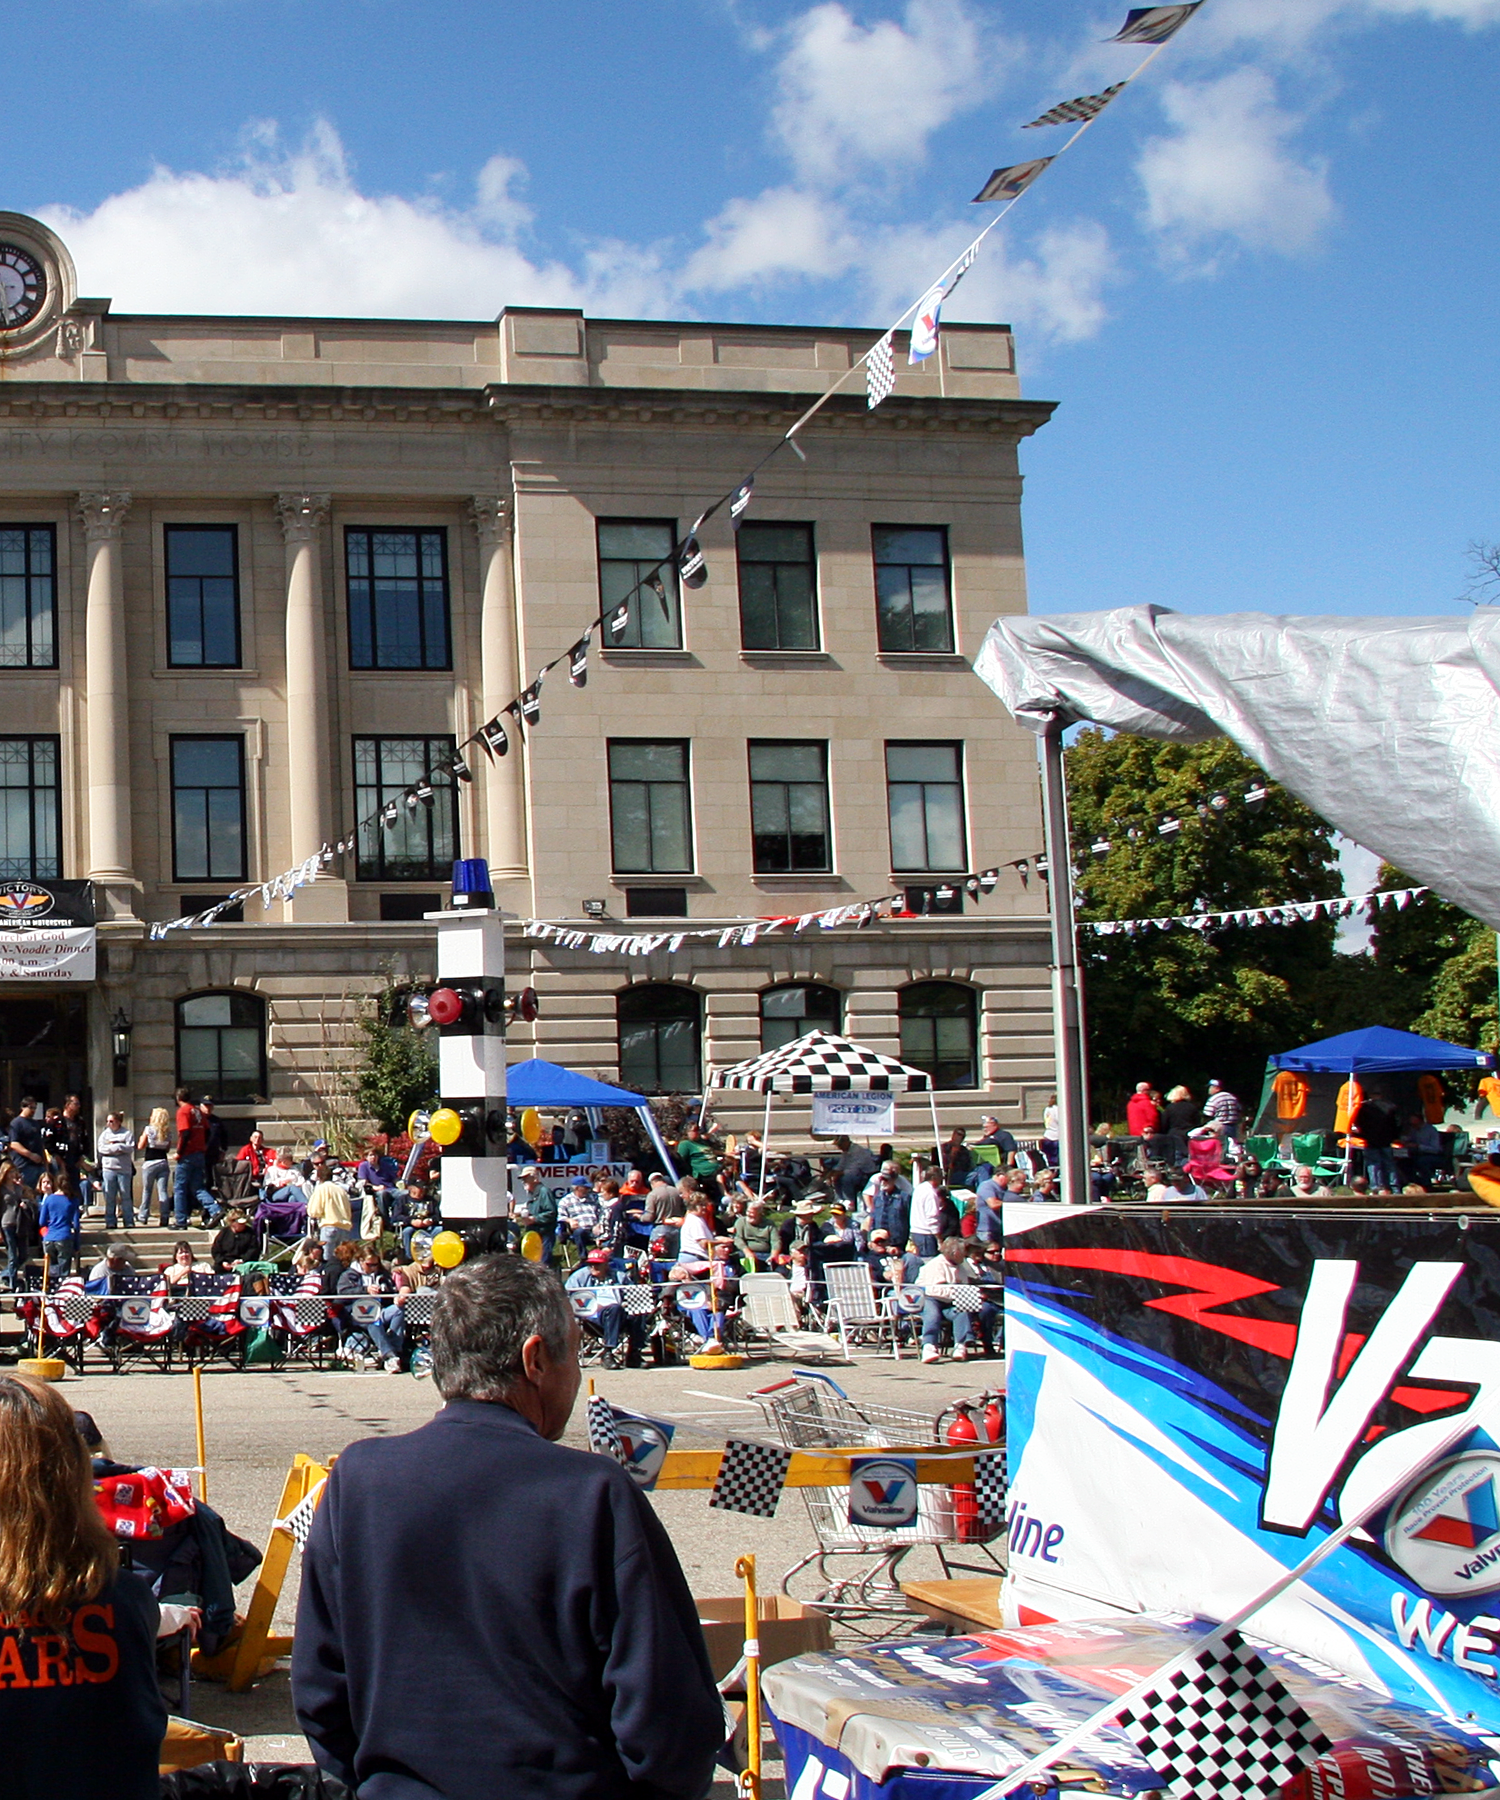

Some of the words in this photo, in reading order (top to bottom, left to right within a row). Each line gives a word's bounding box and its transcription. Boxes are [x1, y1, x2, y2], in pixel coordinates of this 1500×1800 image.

[26, 931, 37, 941] of
[41, 931, 66, 941] God
[54, 944, 92, 954] Dinner
[10, 968, 19, 977] &
[23, 968, 74, 978] Saturday
[813, 1092, 859, 1100] AMERICAN
[861, 1092, 893, 1100] LEGION
[536, 1165, 626, 1178] MERICAN
[1403, 1517, 1424, 1534] Race
[1423, 1495, 1450, 1519] Proven
[1449, 1465, 1489, 1497] Protection
[1411, 1497, 1433, 1517] 100
[1432, 1472, 1467, 1499] Years
[862, 1505, 905, 1515] Valvoline
